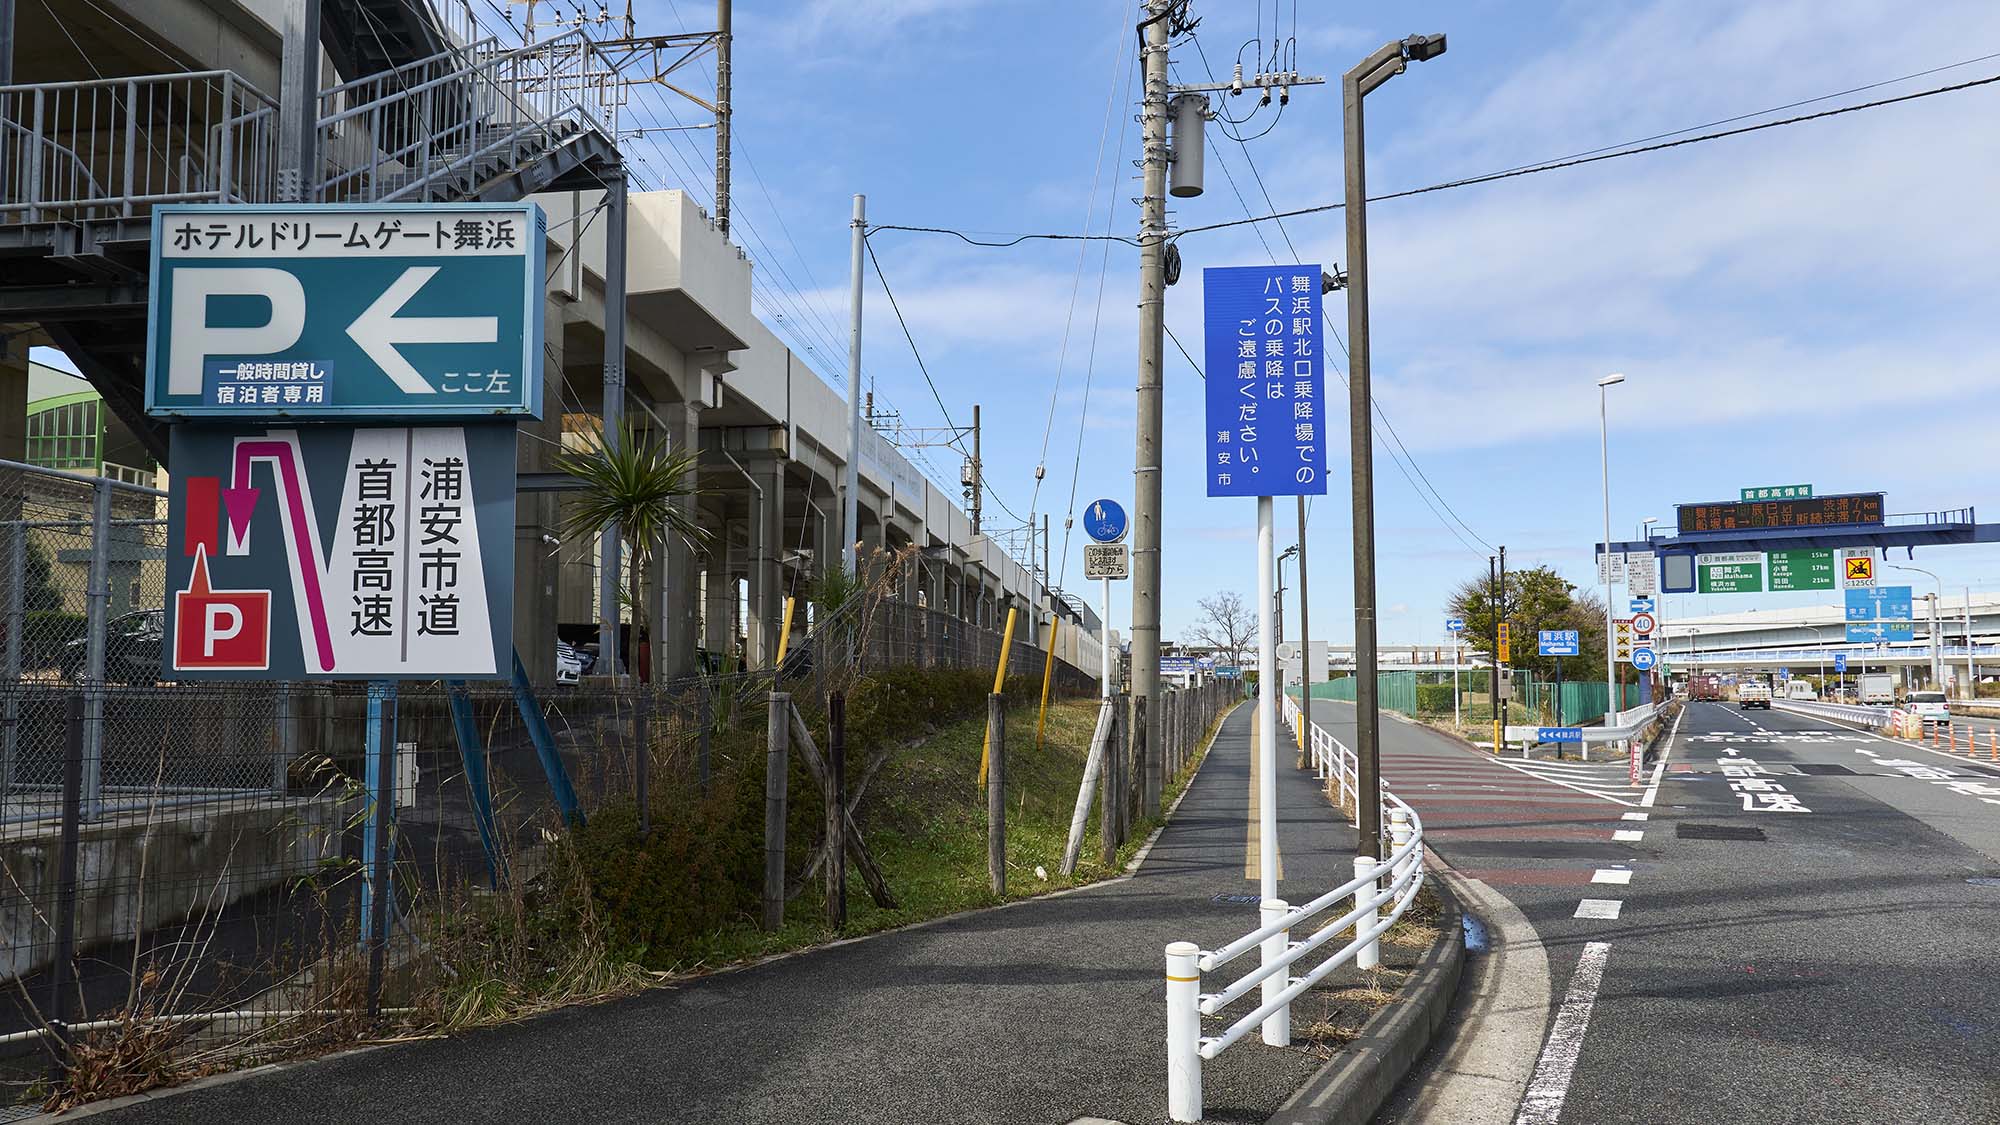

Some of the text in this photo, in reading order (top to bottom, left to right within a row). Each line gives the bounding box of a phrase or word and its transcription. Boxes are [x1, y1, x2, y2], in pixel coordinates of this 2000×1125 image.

[174, 218, 516, 250] ホテルドリームゲート舞浜
[168, 267, 306, 395] P
[1263, 276, 1285, 400] バスの乗降は
[218, 363, 325, 381] 一般時間貸し
[441, 369, 511, 394] ここ左
[1291, 275, 1315, 484] 舞浜駅北口乗降場での
[217, 385, 323, 404] 宿泊者専用
[1237, 319, 1259, 474] ご遠慮ください。
[1217, 430, 1231, 486] 浦安市
[1745, 487, 1808, 499] 首都高情報
[350, 458, 397, 638] 首都高速
[417, 457, 463, 637] 浦安市道
[1848, 550, 1868, 558] 原付
[1088, 566, 1124, 575] ここから
[203, 603, 244, 657] P
[1542, 631, 1576, 641] 舞浜駅
[1636, 618, 1650, 629] 40
